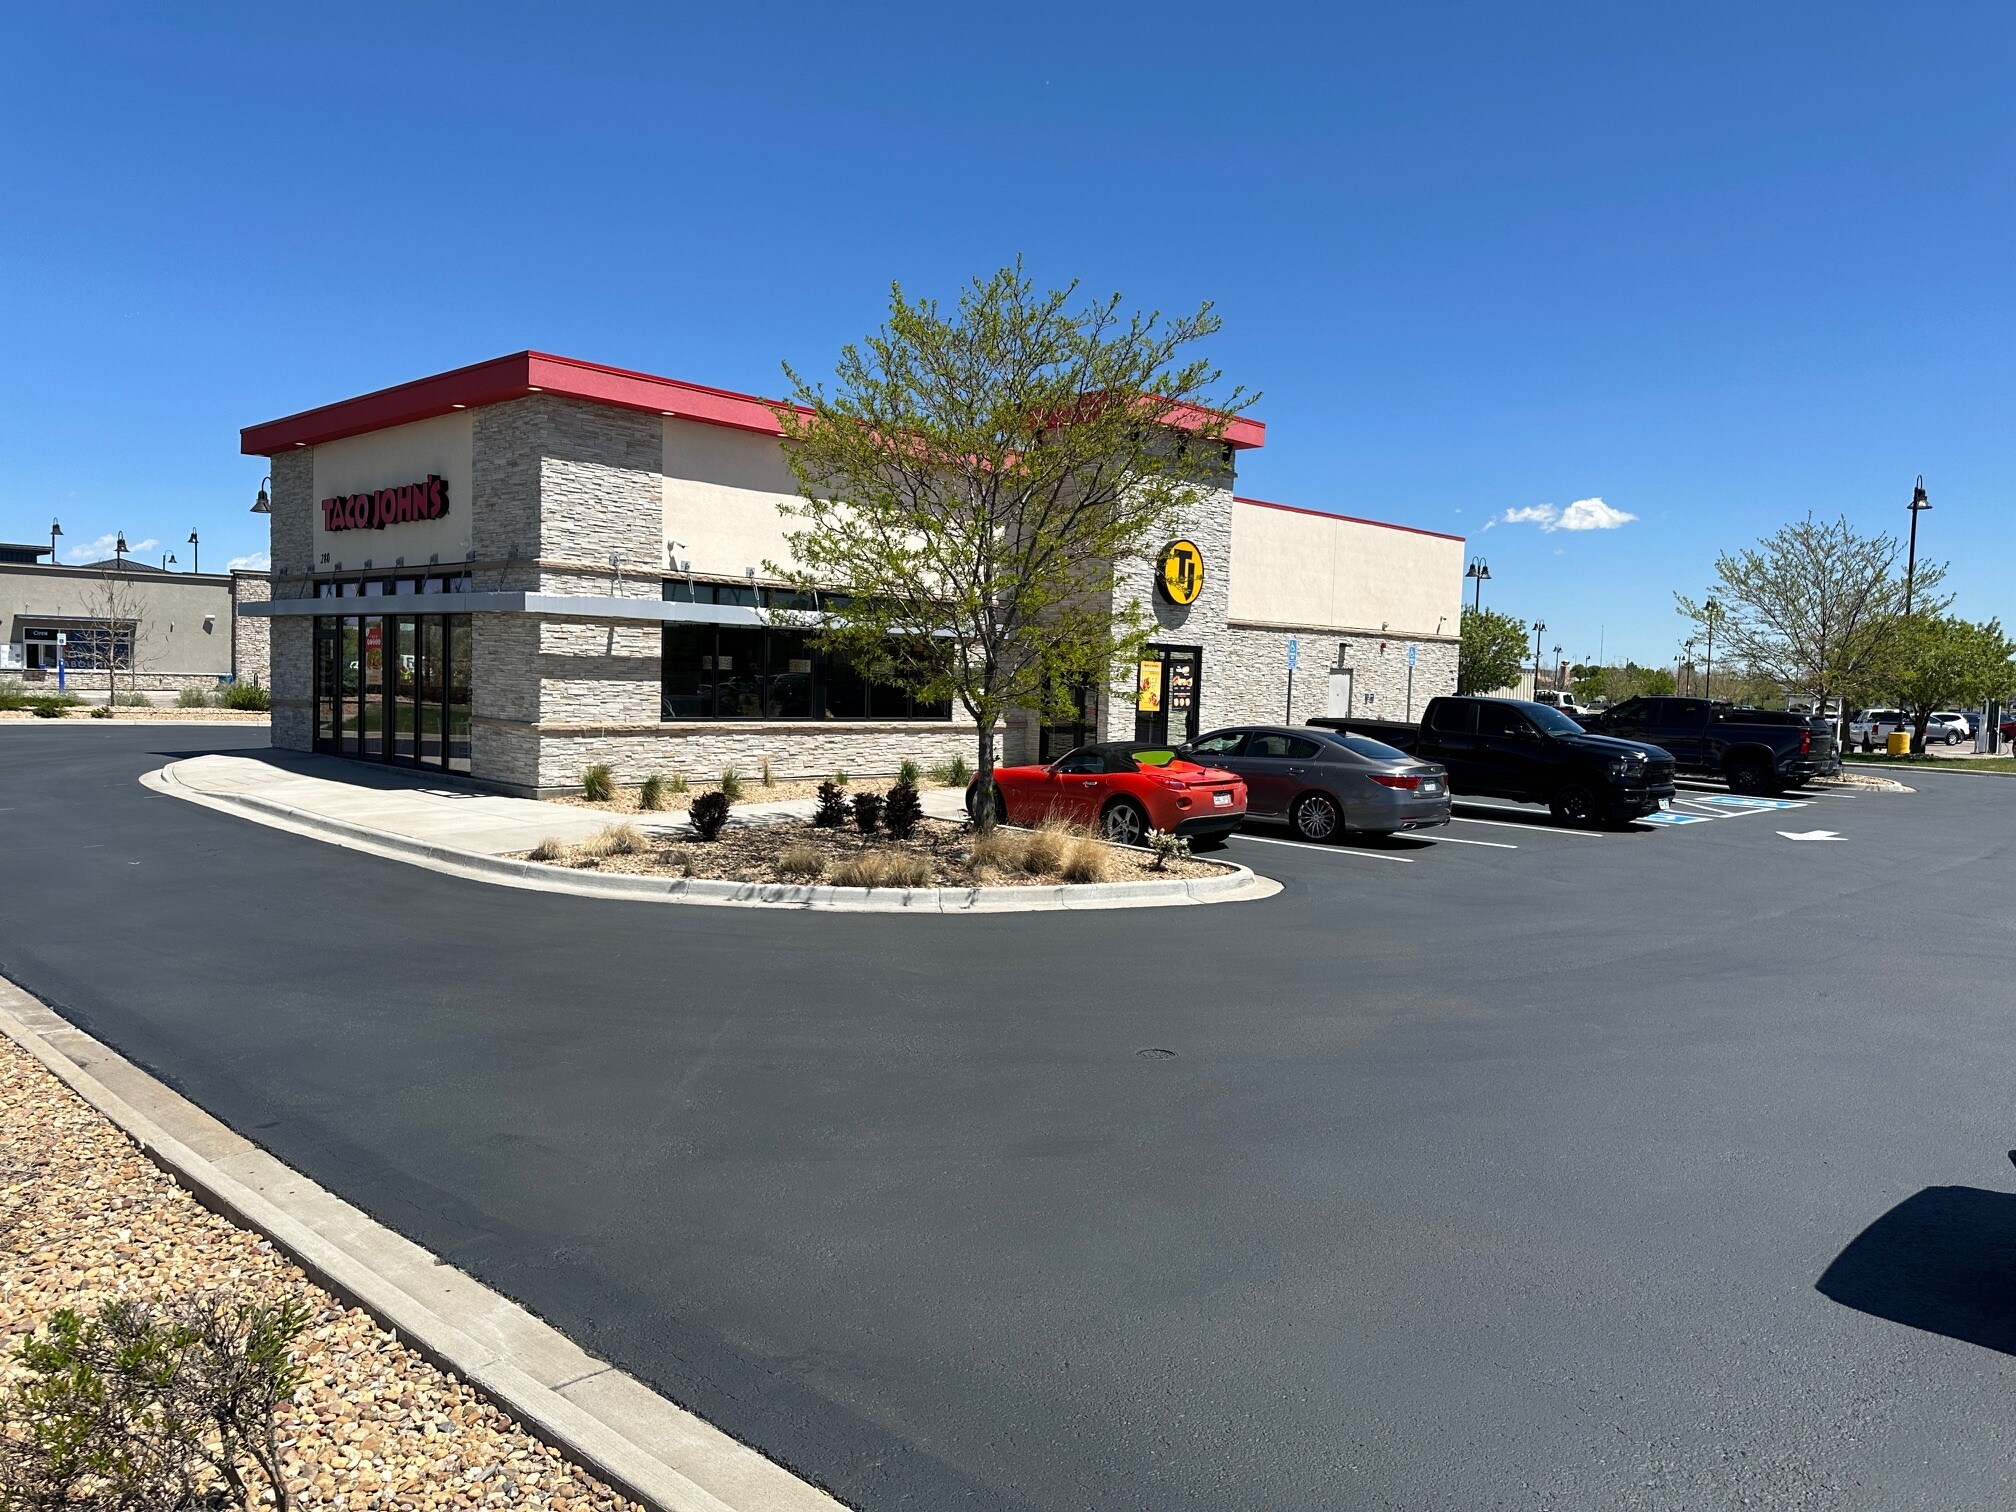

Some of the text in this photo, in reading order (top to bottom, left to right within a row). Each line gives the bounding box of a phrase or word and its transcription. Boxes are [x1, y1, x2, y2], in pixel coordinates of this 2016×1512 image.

[322, 474, 446, 531] TACO JOHN'S
[320, 553, 331, 564] 280
[1174, 549, 1195, 601] TJ
